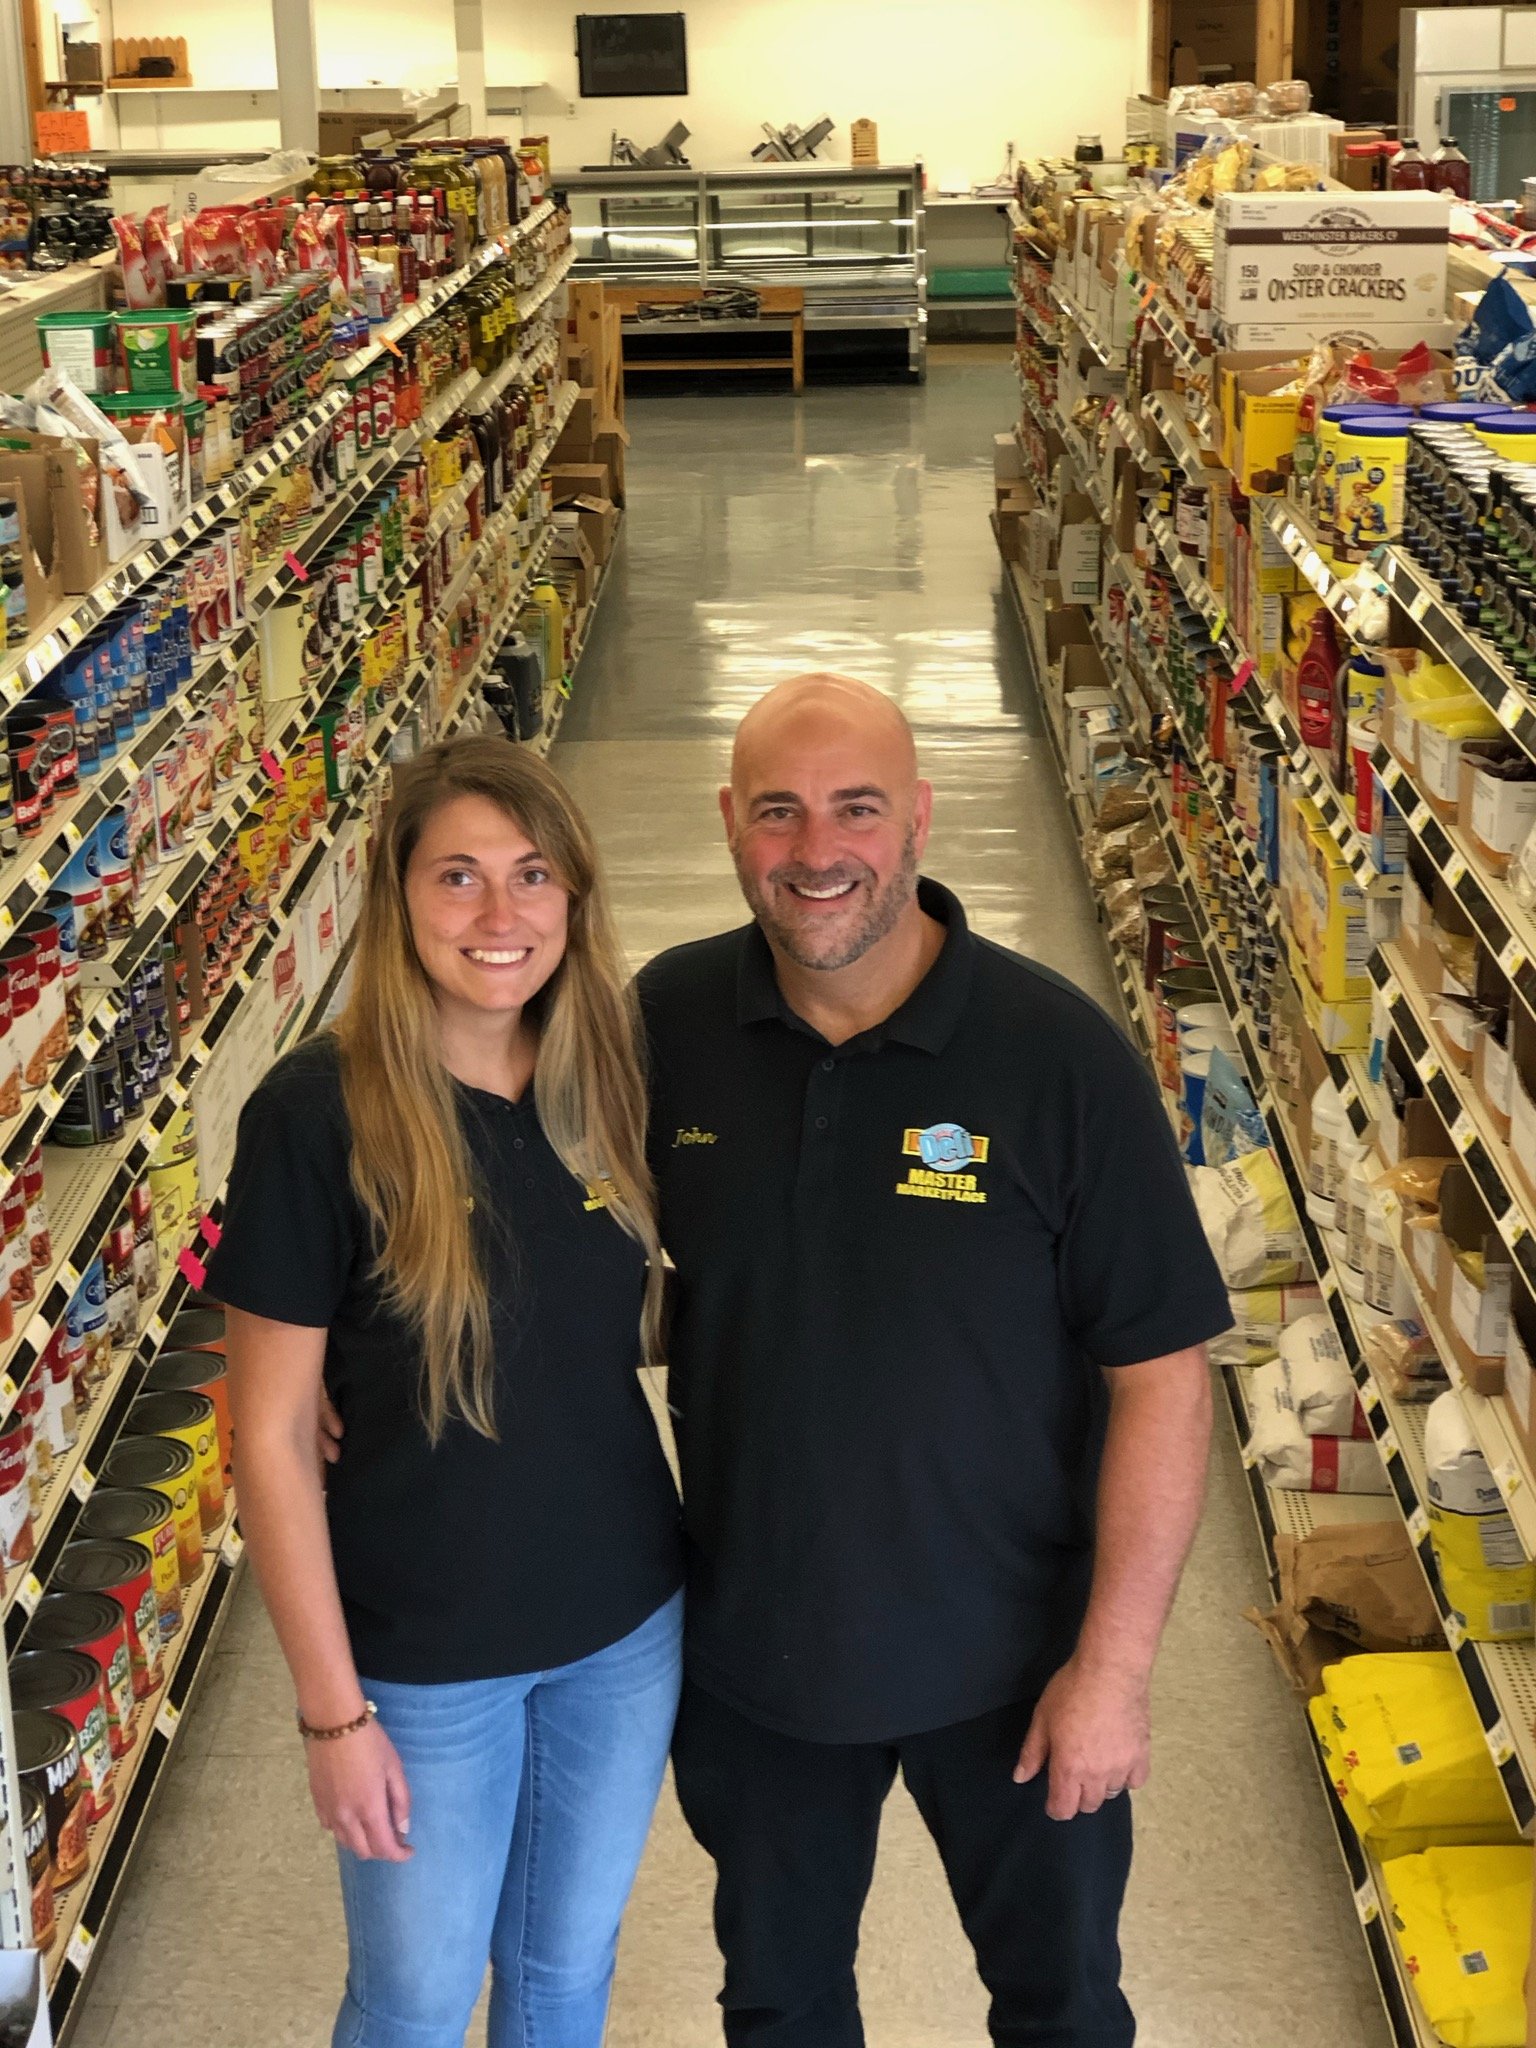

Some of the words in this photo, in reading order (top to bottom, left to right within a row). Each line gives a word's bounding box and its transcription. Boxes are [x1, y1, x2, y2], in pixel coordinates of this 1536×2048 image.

[1282, 230, 1347, 242] WESTMINSTER
[1349, 230, 1385, 242] BAKERS
[1241, 264, 1258, 278] 150
[1293, 263, 1320, 278] SOUP
[1323, 263, 1330, 277] &
[1333, 262, 1383, 277] CHOWDER
[1267, 278, 1324, 302] OYSTER
[1328, 278, 1407, 302] CRACKERS
[671, 1127, 719, 1148] John
[918, 1129, 975, 1164] Deli
[907, 1168, 977, 1191] MASTER
[895, 1183, 988, 1203] MARKETPLACE
